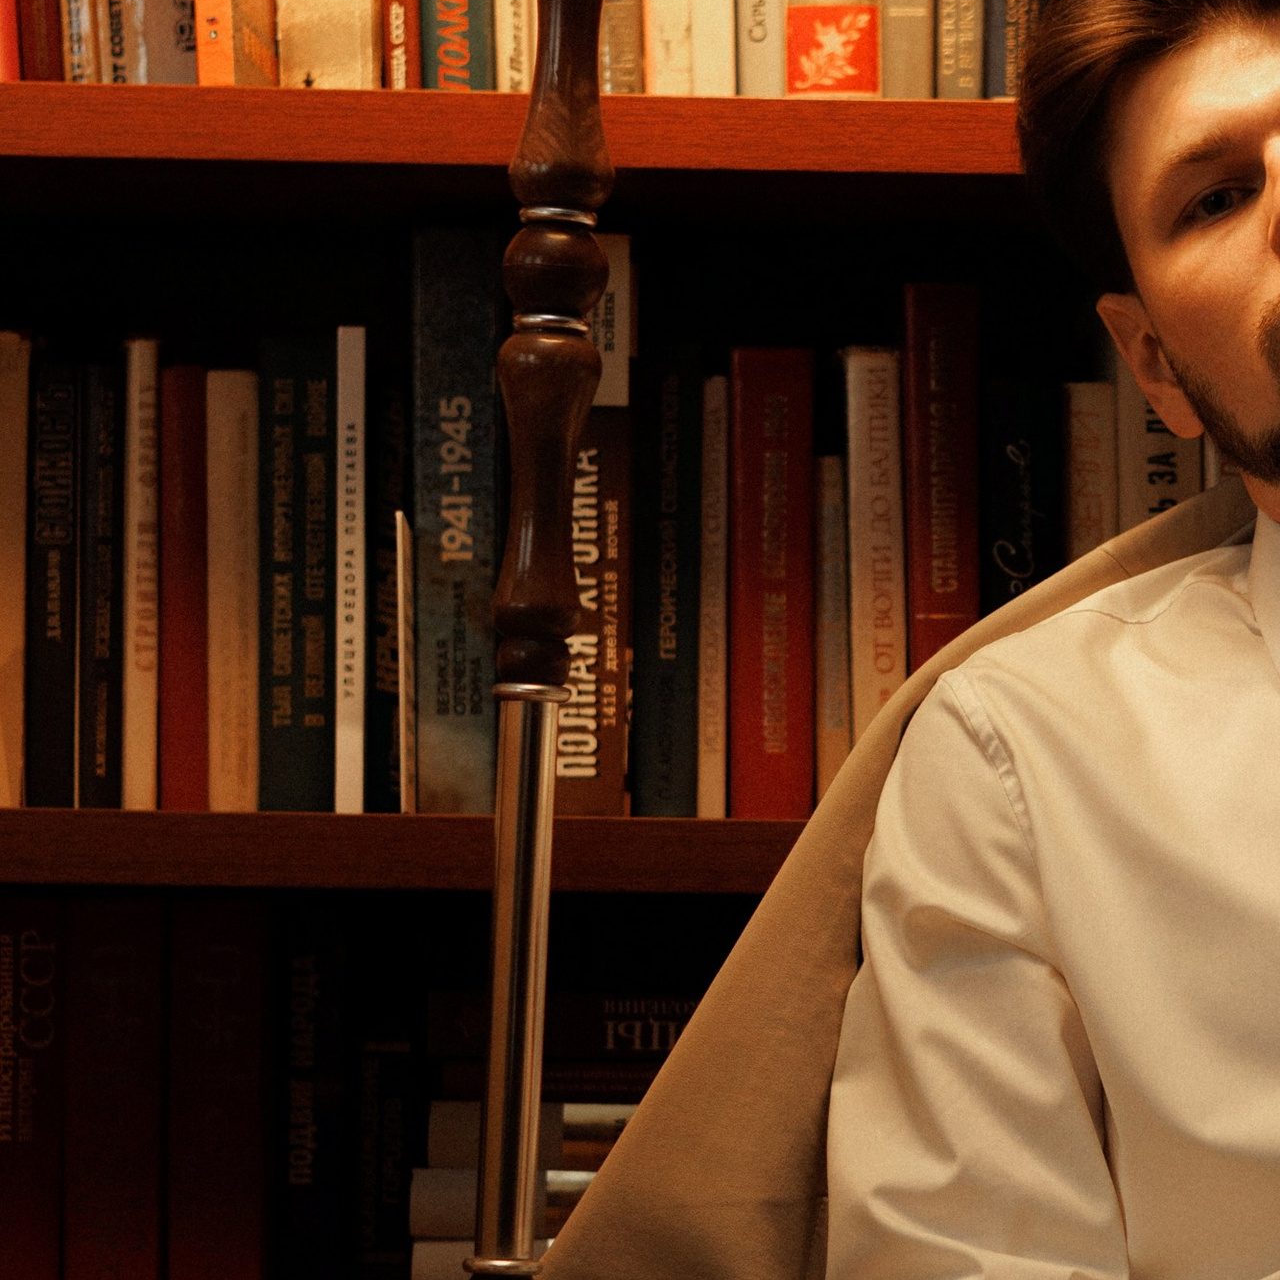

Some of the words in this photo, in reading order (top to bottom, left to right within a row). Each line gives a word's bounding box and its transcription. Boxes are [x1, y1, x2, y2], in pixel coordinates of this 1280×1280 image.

[867, 366, 892, 488] БАЛТИКИ
[1148, 452, 1178, 486] ЗА
[344, 423, 356, 538] ПОЛЕТАЕВА
[439, 396, 474, 564] 1941-1945
[872, 495, 893, 534] ДО
[602, 500, 618, 560] ночей
[272, 574, 292, 677] СОВЕТСКИХ
[344, 548, 356, 625] ФЕДОРА
[602, 571, 618, 673] дней/1418
[657, 522, 679, 661] ГЕРОИЧЕСКИЙ
[871, 544, 894, 632] ВОЛГИ
[343, 637, 356, 699] УЛИЦА
[436, 639, 449, 716] ВЕЛИКАЯ
[453, 580, 467, 716] ОТЕЧЕСТВЕННАЯ
[469, 656, 483, 716] ВОЙНА
[873, 642, 895, 675] ОТ
[273, 686, 292, 727] ТЫЛ
[557, 633, 599, 778] ПОЛНАЯ
[603, 683, 618, 728] 1418
[19, 929, 57, 1051] СССР
[290, 955, 320, 1068] НАРОДА
[289, 1080, 318, 1186] ПОДВИГ
